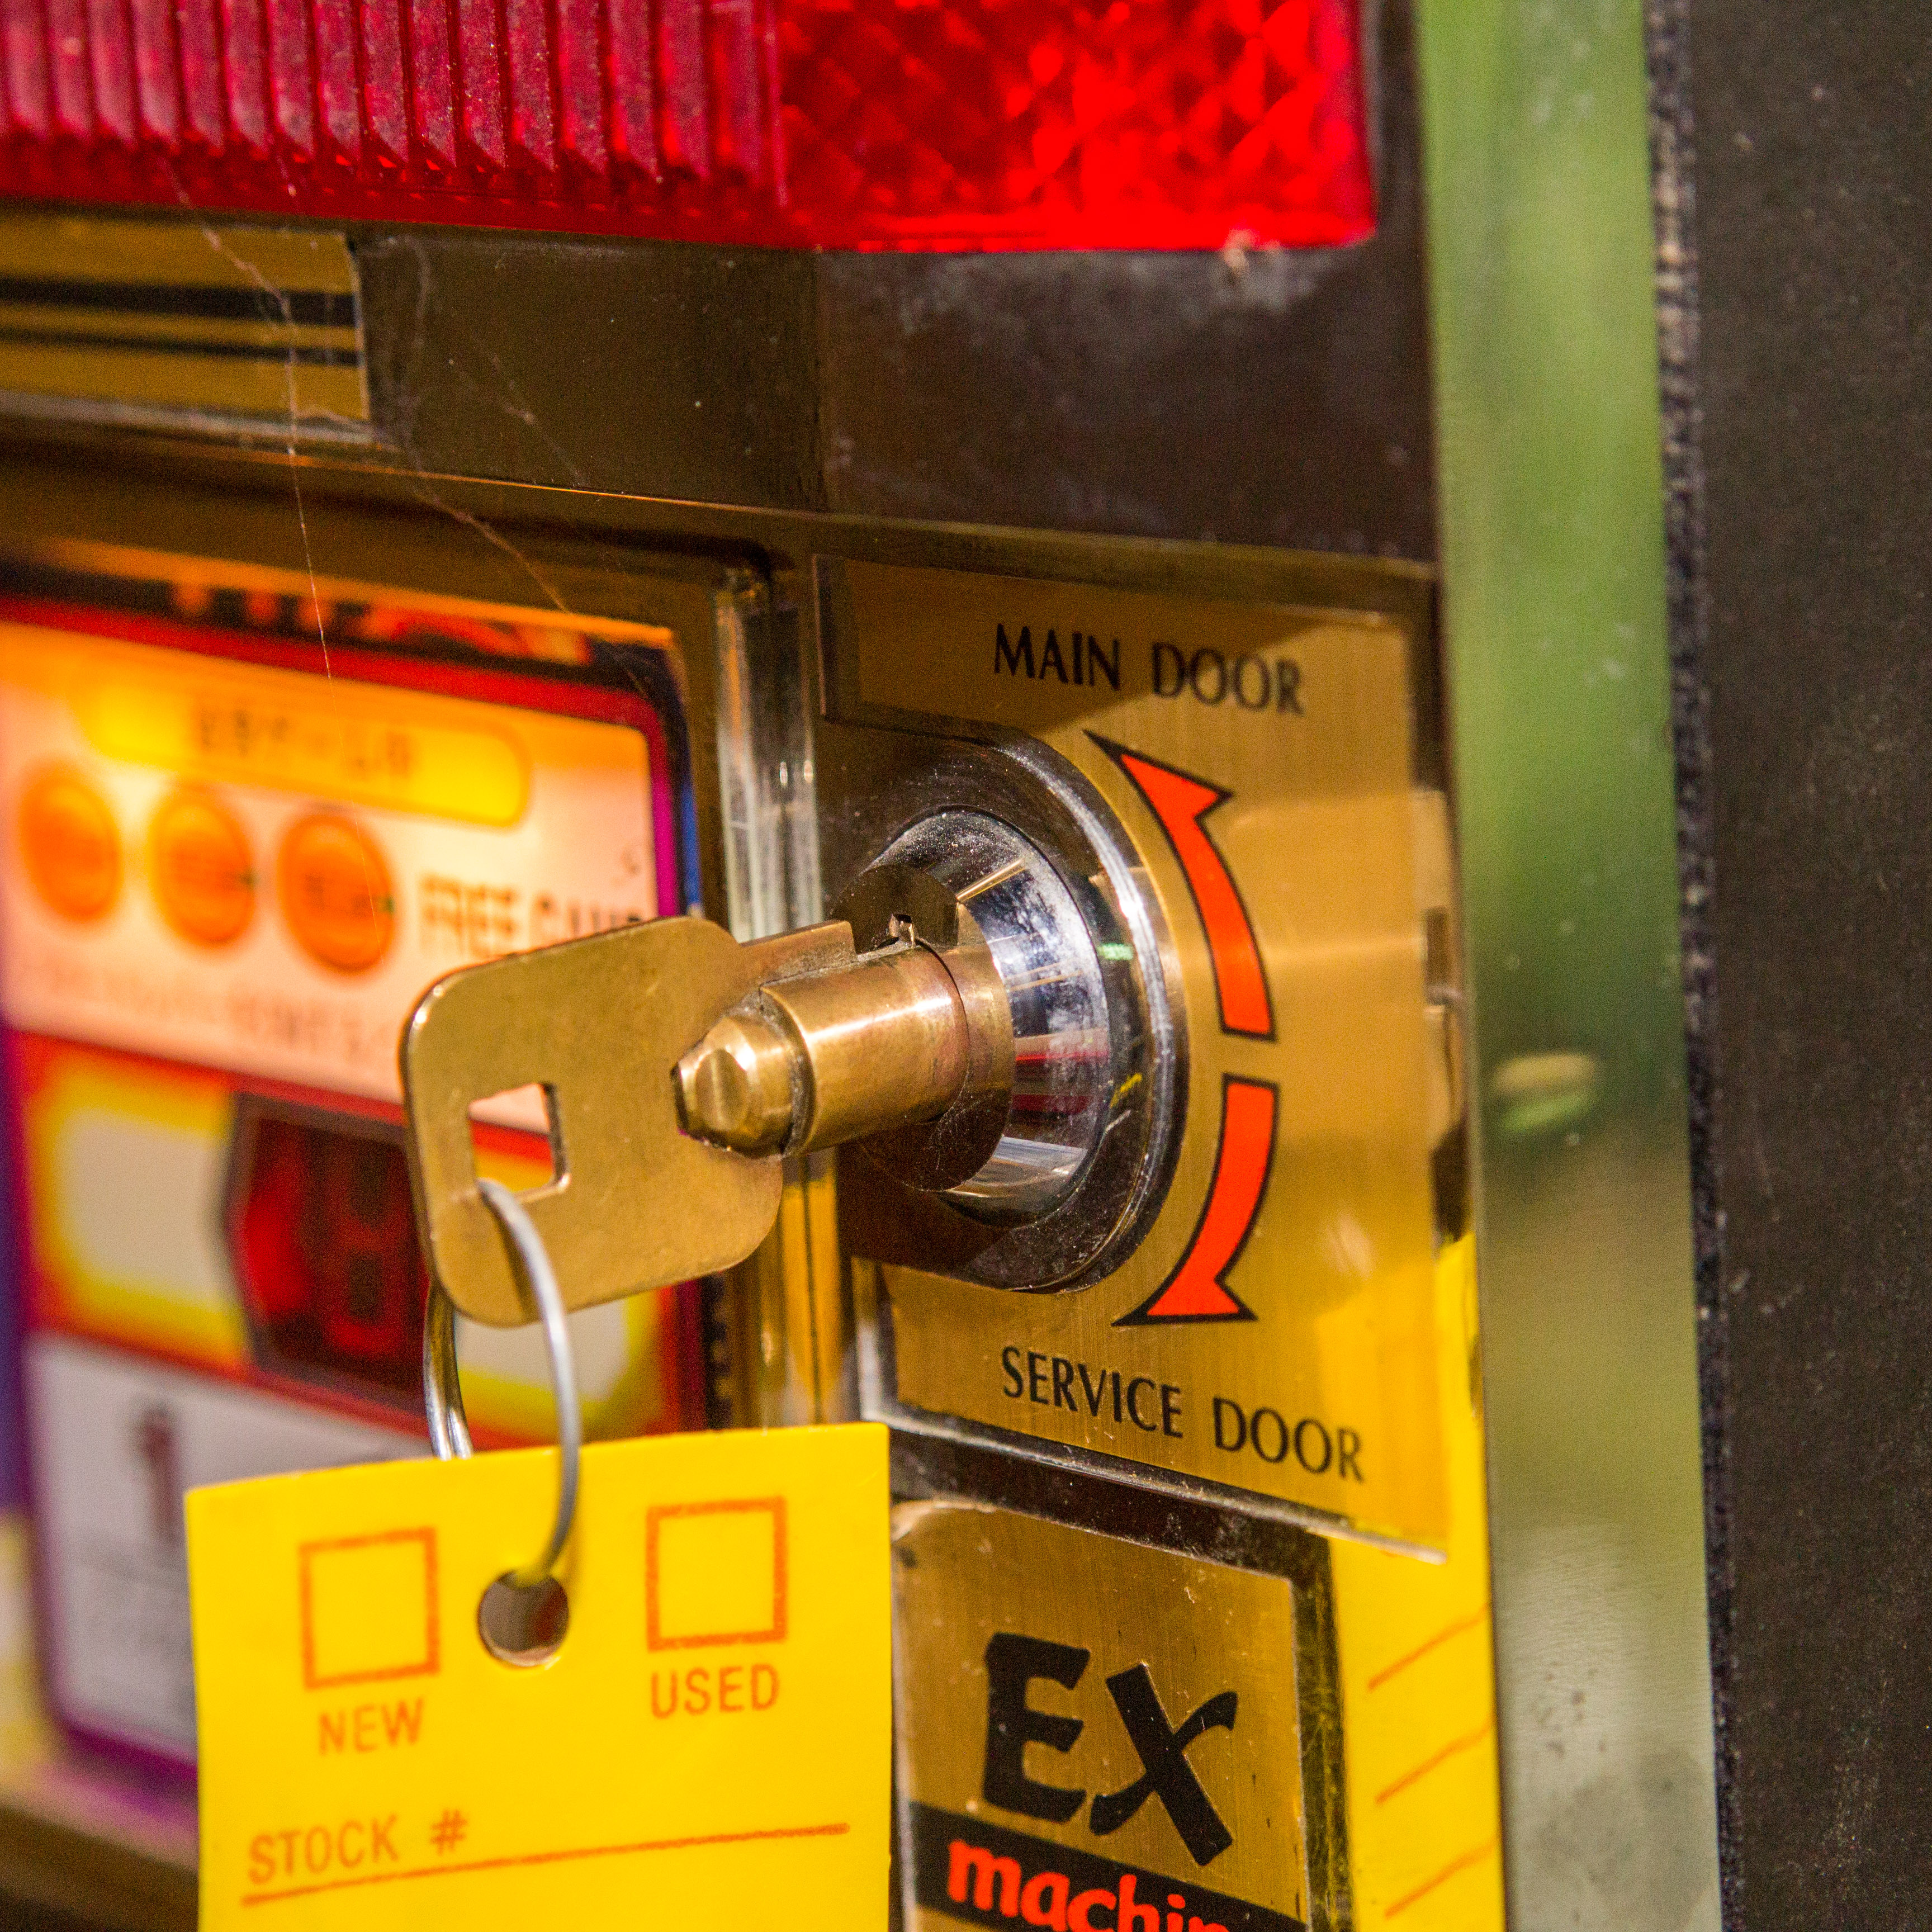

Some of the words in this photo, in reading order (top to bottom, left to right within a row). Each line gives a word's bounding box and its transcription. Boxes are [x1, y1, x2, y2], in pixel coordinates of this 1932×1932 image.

[995, 623, 1119, 690] MAIN
[1152, 641, 1305, 716] DOOR
[1002, 1346, 1183, 1438] SERVICE
[1213, 1398, 1363, 1484] DOOR
[318, 1697, 425, 1755] NEW
[650, 1663, 780, 1719] USED
[248, 1814, 399, 1885] STOCK
[430, 1810, 468, 1854] #
